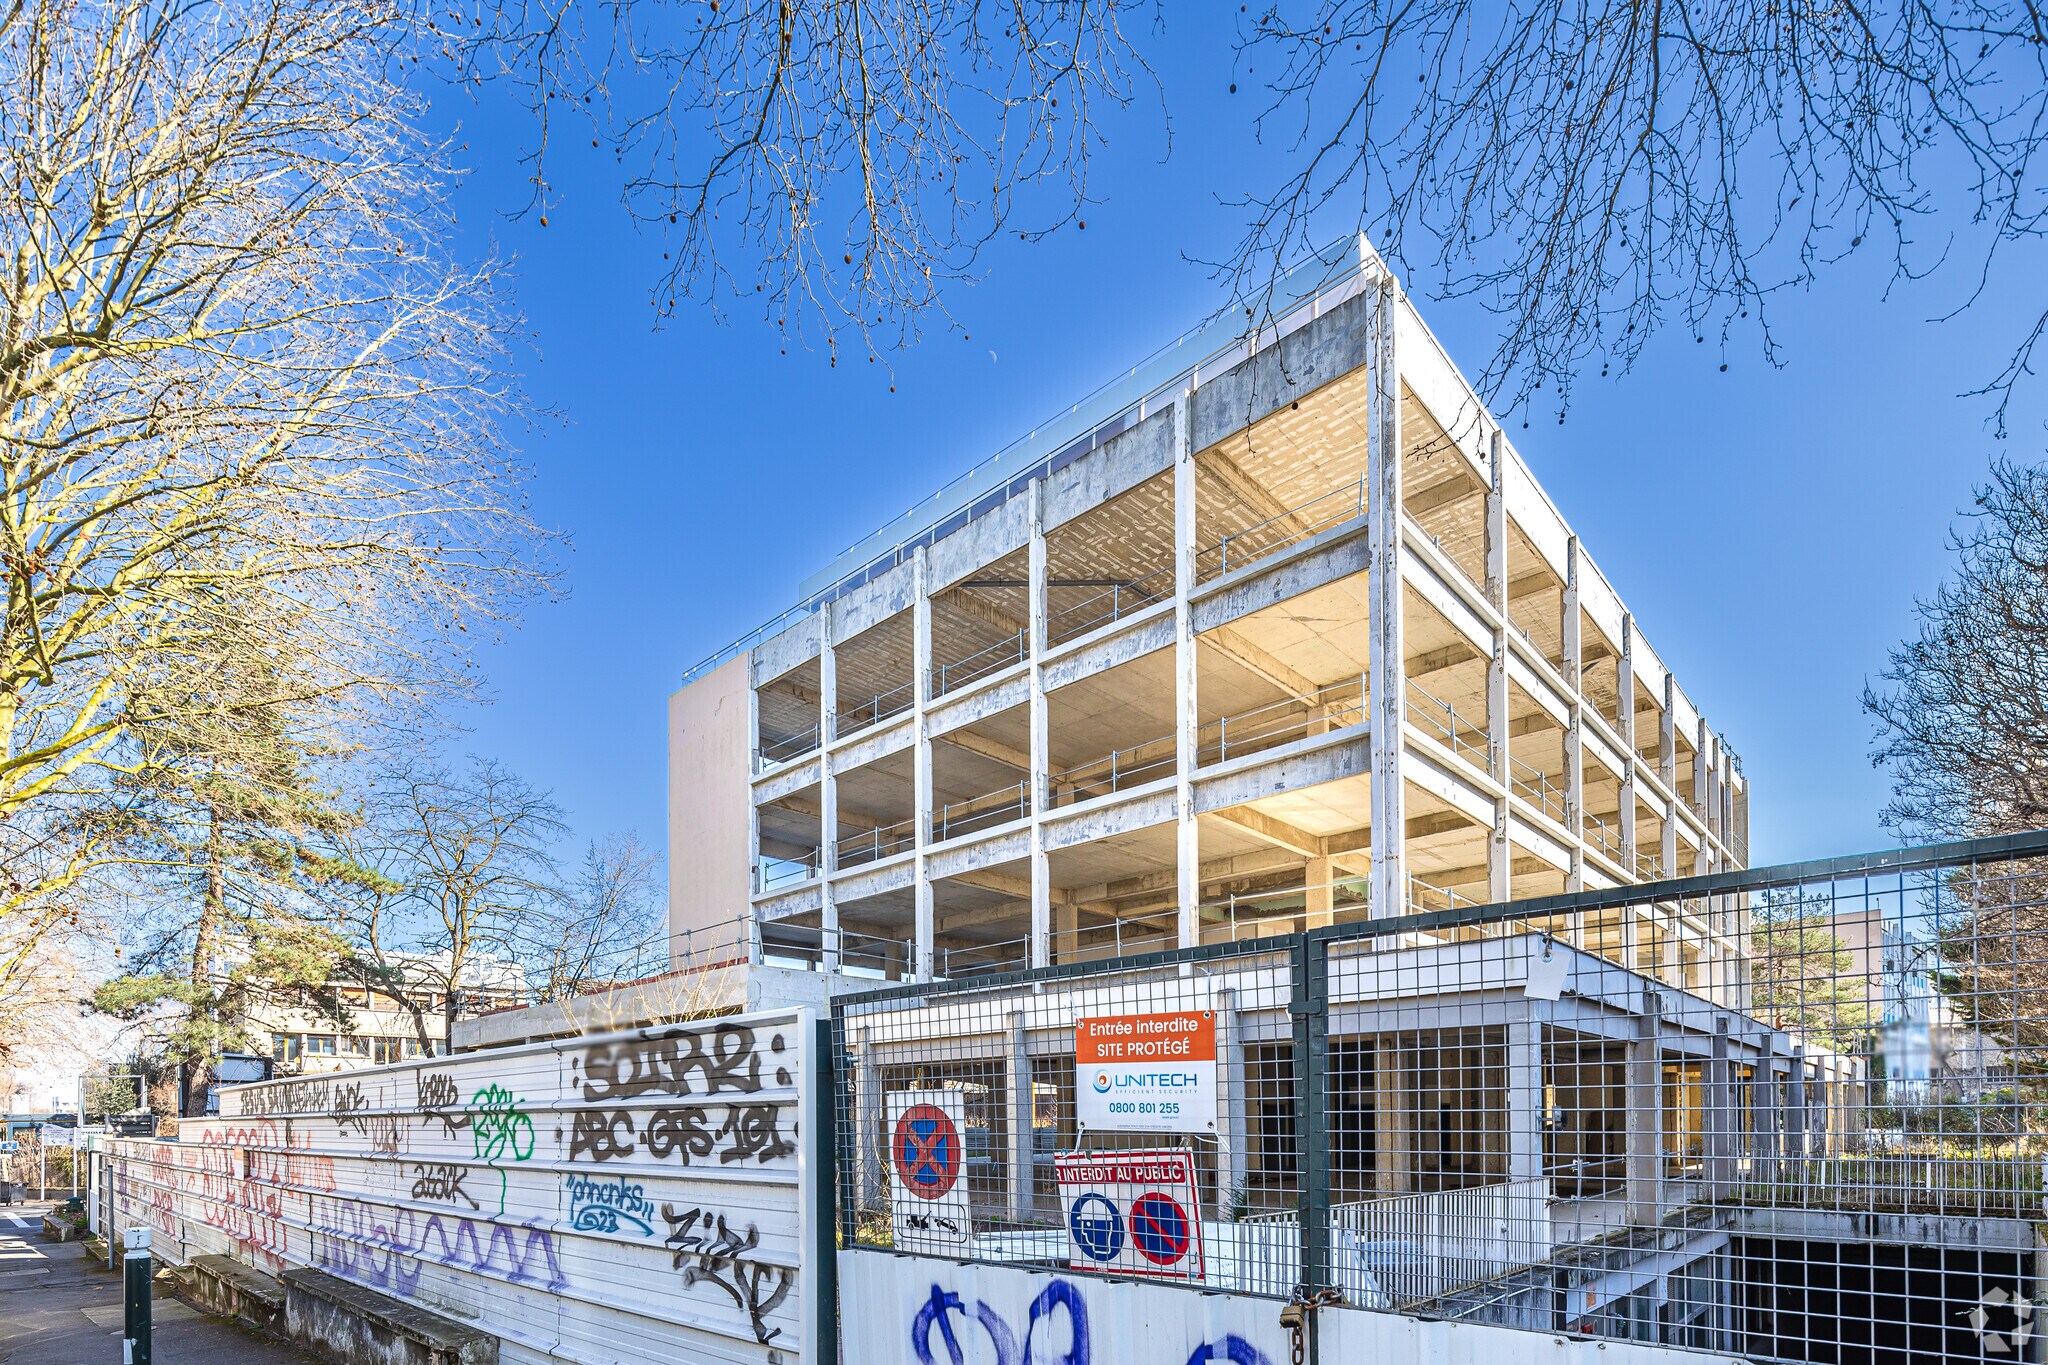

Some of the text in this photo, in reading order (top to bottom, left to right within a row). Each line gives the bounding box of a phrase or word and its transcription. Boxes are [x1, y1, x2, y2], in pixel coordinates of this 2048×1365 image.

[1090, 1017, 1198, 1036] Entrée interdite
[1097, 1037, 1190, 1057] SITE PROTÉGÉ
[1115, 1073, 1198, 1087] UNITECH
[1109, 1102, 1180, 1114] 0800 801 255
[1063, 1167, 1113, 1181] INTERDIT
[1117, 1167, 1132, 1181] AU
[1136, 1165, 1181, 1181] PUBLIC
